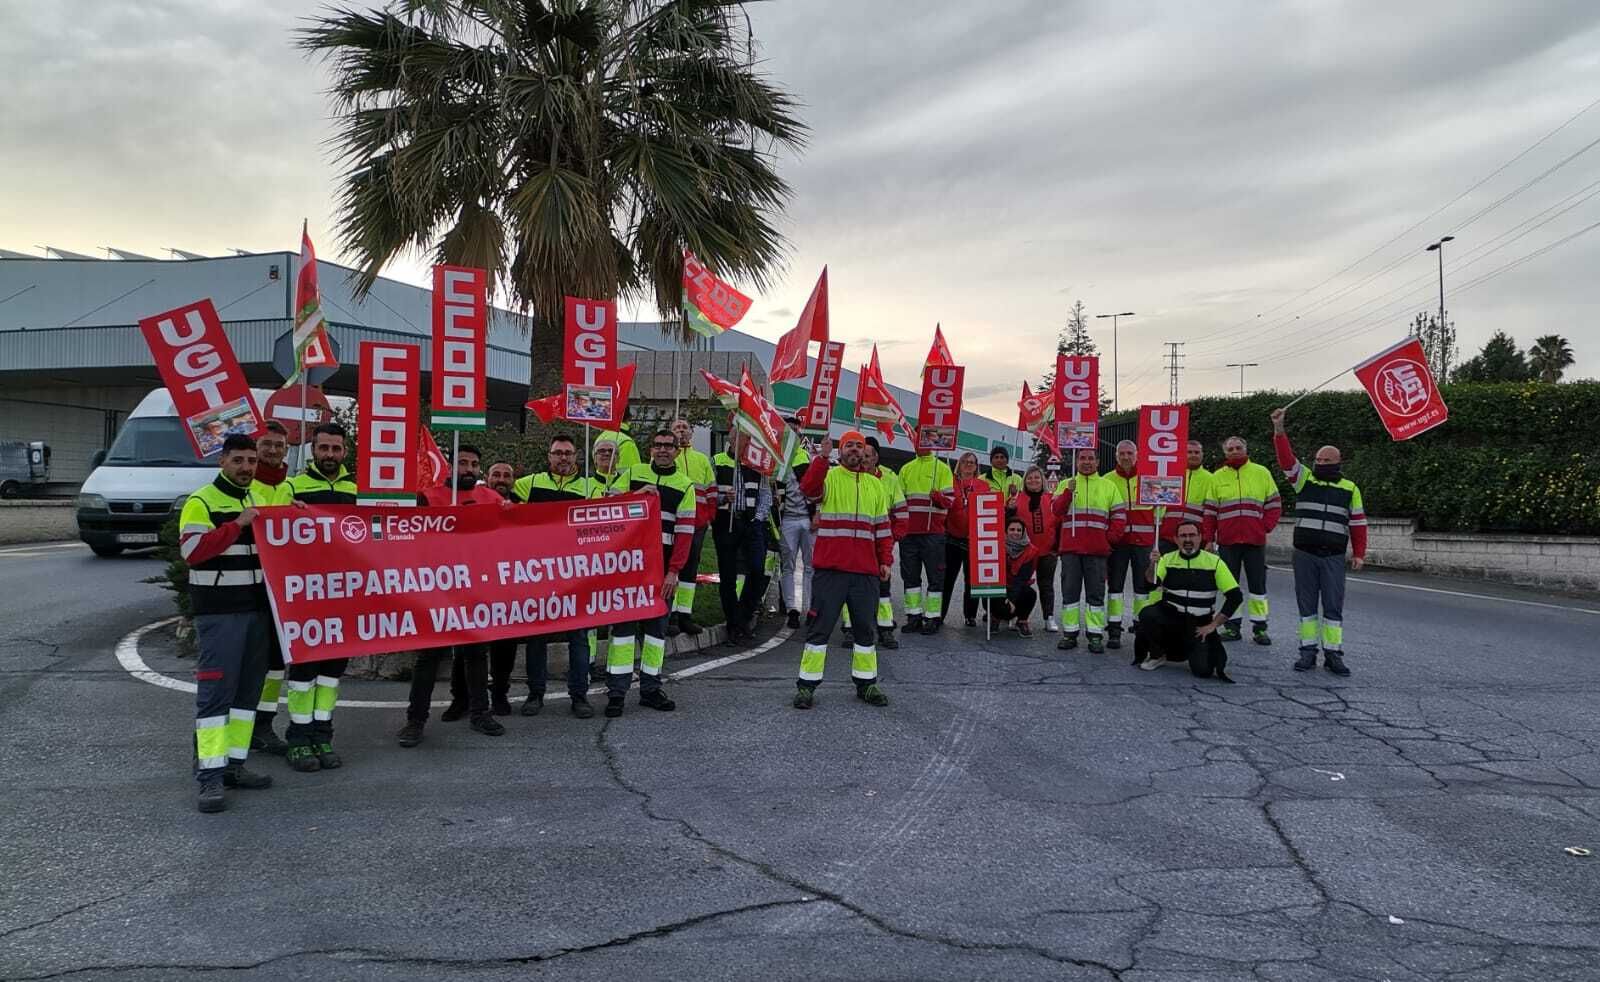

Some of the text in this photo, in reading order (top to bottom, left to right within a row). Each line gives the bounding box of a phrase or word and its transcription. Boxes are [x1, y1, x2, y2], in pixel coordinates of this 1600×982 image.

[157, 309, 230, 409] UGT
[443, 270, 475, 407] CCOO
[574, 304, 606, 386] UGT
[810, 341, 841, 424] CCOO
[927, 368, 957, 427] UGT
[1063, 360, 1091, 423] UGT
[1391, 364, 1427, 405] UGT
[369, 346, 407, 489] CCOO
[1148, 410, 1179, 477] UGT
[265, 516, 336, 547] UGT
[386, 515, 457, 533] FeSMC
[387, 533, 416, 542] Granada
[573, 505, 624, 522] CCOO
[576, 524, 626, 537] servicios
[577, 534, 611, 545] granada
[976, 494, 1000, 584] CCOO
[284, 564, 471, 602] PREPARADOR
[497, 548, 644, 586] FACTURADOR
[284, 584, 656, 649] POR UNA VALORACIÓN JUSTA!
